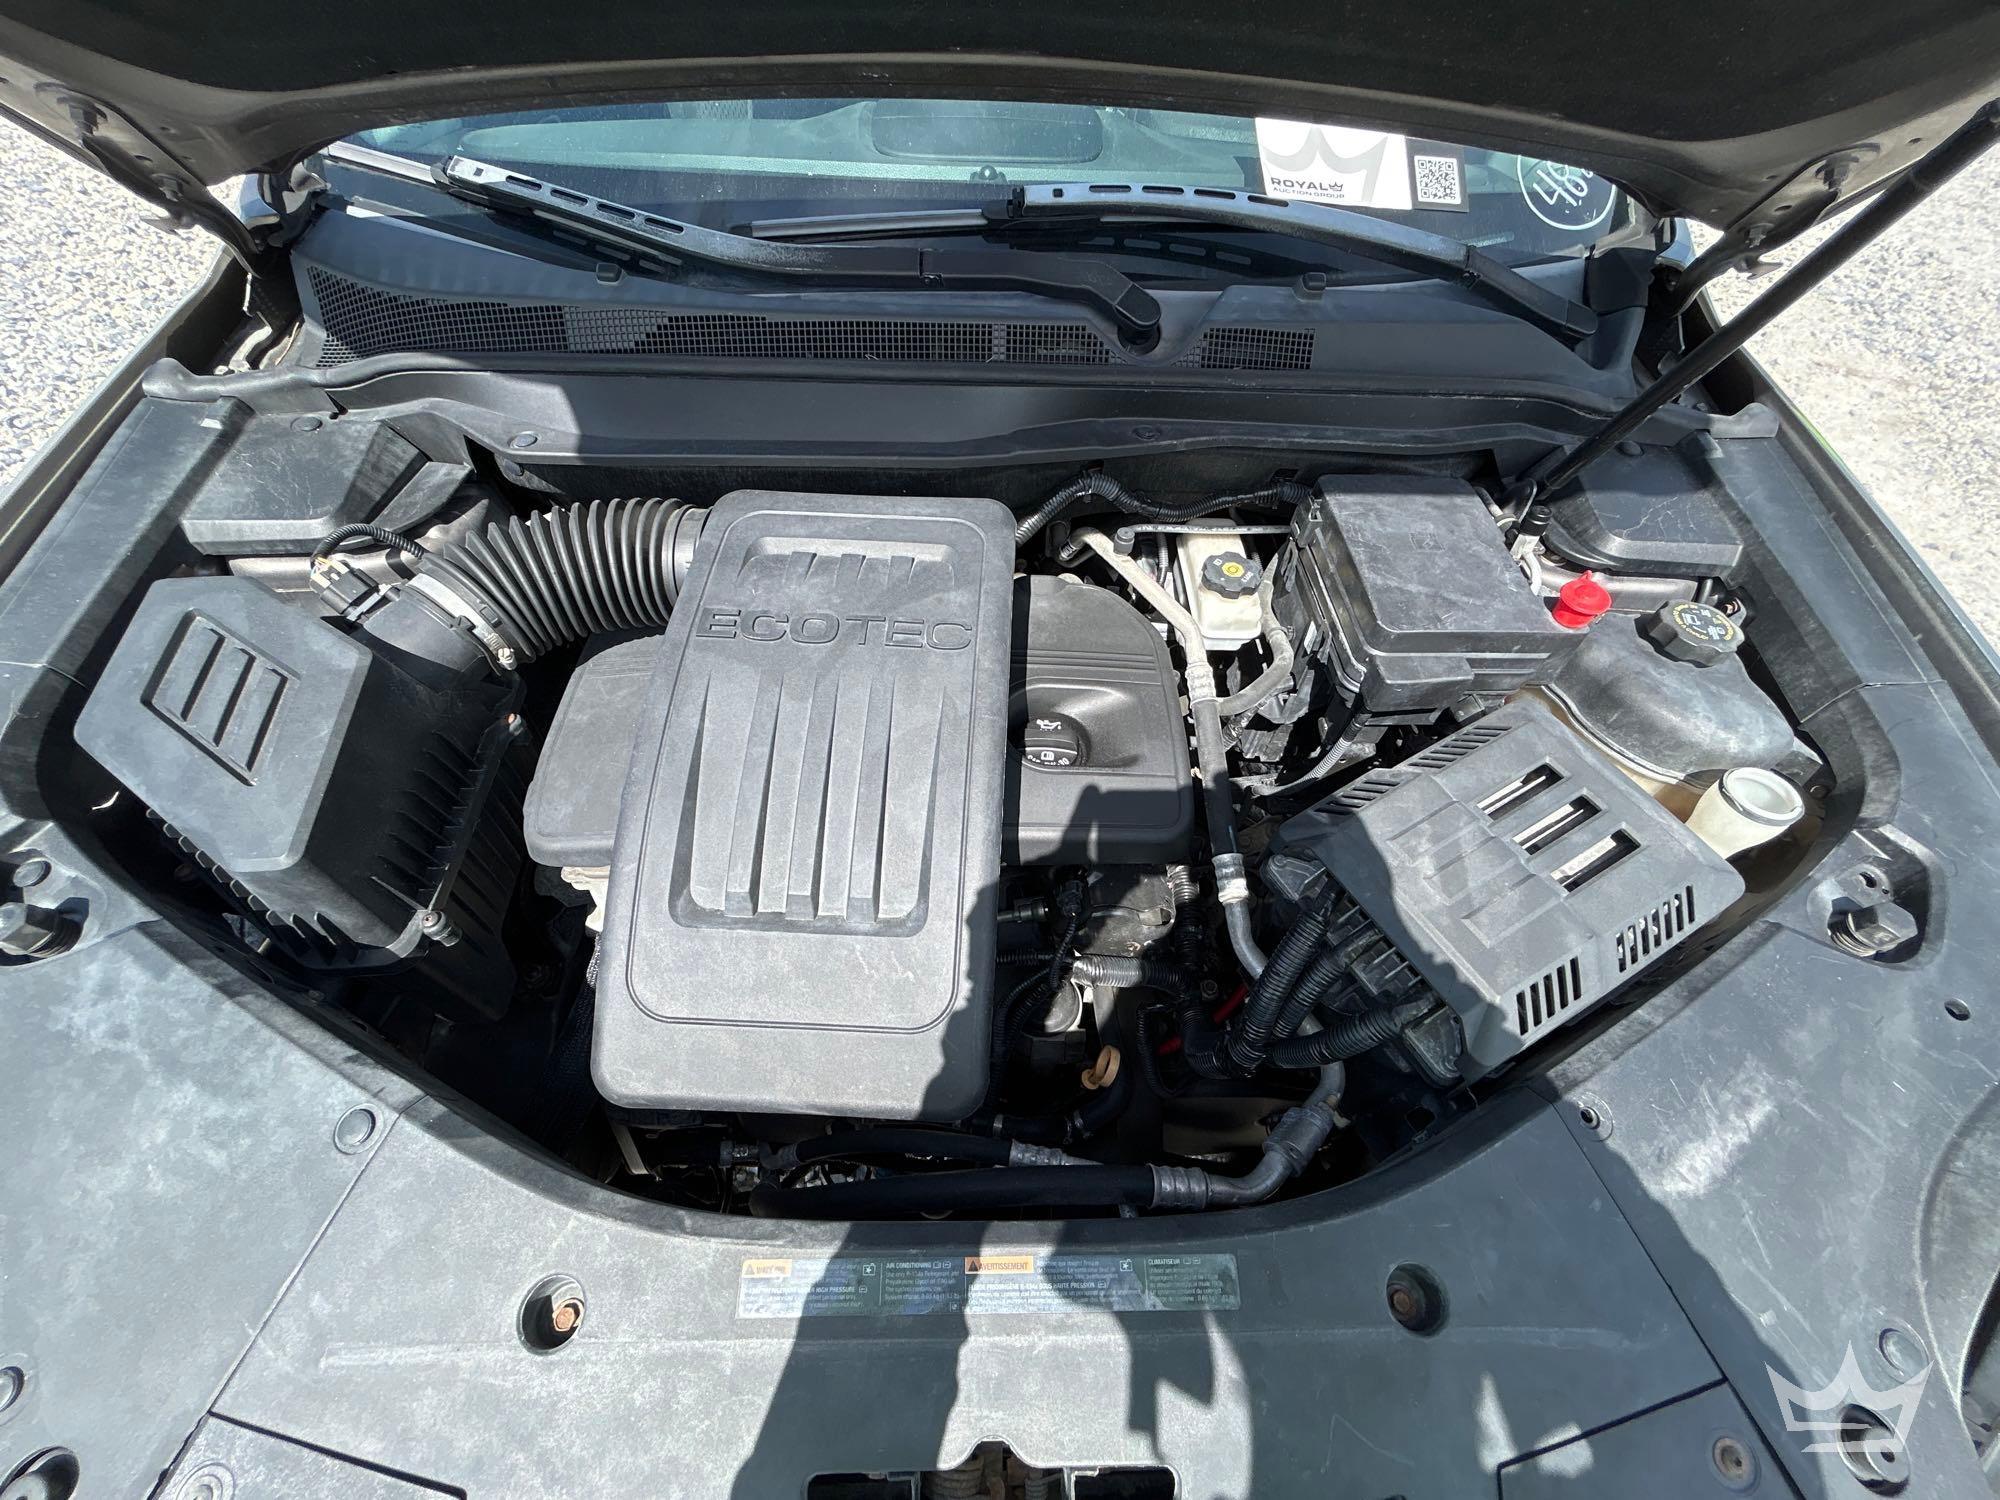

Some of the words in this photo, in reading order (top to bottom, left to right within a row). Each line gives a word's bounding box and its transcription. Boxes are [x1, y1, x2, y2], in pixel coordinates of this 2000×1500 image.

[1271, 177, 1329, 191] ROYAL
[1273, 187, 1312, 196] AUCTION
[695, 607, 973, 650] ECOTEC
[978, 1262, 1028, 1270] AVERTISSEMENT
